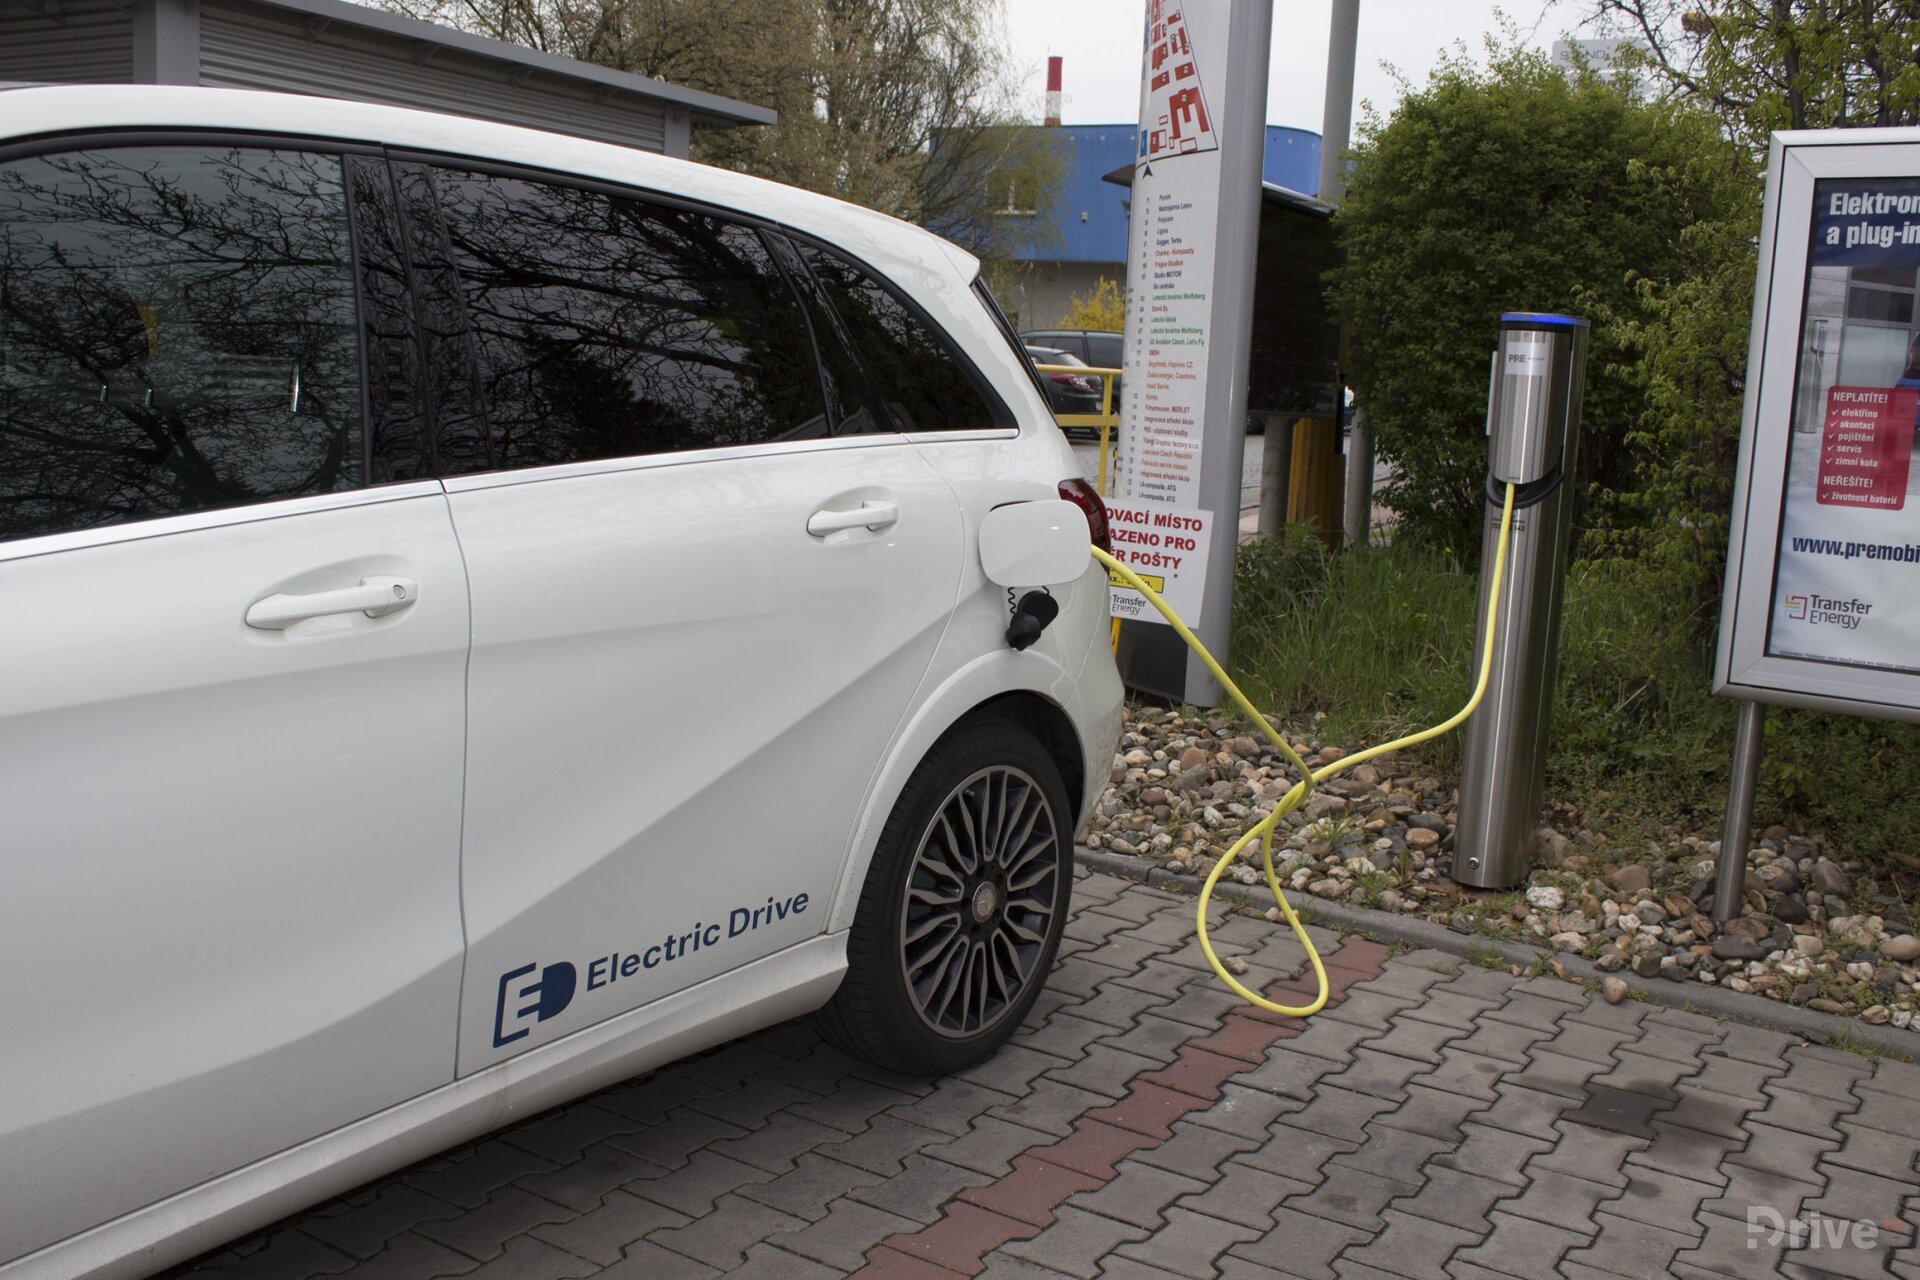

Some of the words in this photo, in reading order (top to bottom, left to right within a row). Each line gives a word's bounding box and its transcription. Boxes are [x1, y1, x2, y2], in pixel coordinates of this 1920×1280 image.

[1826, 224, 1840, 245] a
[1846, 221, 1920, 248] plug-in
[1508, 354, 1526, 363] PRE
[1833, 391, 1888, 404] NEPLATÍTE!
[1841, 408, 1878, 418] elektřinu
[1837, 432, 1875, 443] pojištění
[1836, 445, 1862, 454] servis
[1835, 457, 1858, 466] zimní
[1860, 458, 1878, 468] kola
[1823, 475, 1873, 488] NEŘEŠÍTE!
[1831, 492, 1868, 503] životnost
[1869, 494, 1898, 505] baterií
[1106, 508, 1150, 525] OVACÍ
[1154, 513, 1203, 532] MÍSTO
[1164, 536, 1196, 551] PRO
[1130, 551, 1182, 569] POŠTY
[1112, 594, 1147, 607] Transfer
[1810, 594, 1872, 615] Transfer
[1112, 603, 1140, 615] Energy
[1809, 610, 1861, 630] Energy
[586, 922, 720, 992] Electric
[728, 893, 809, 939] Drive
